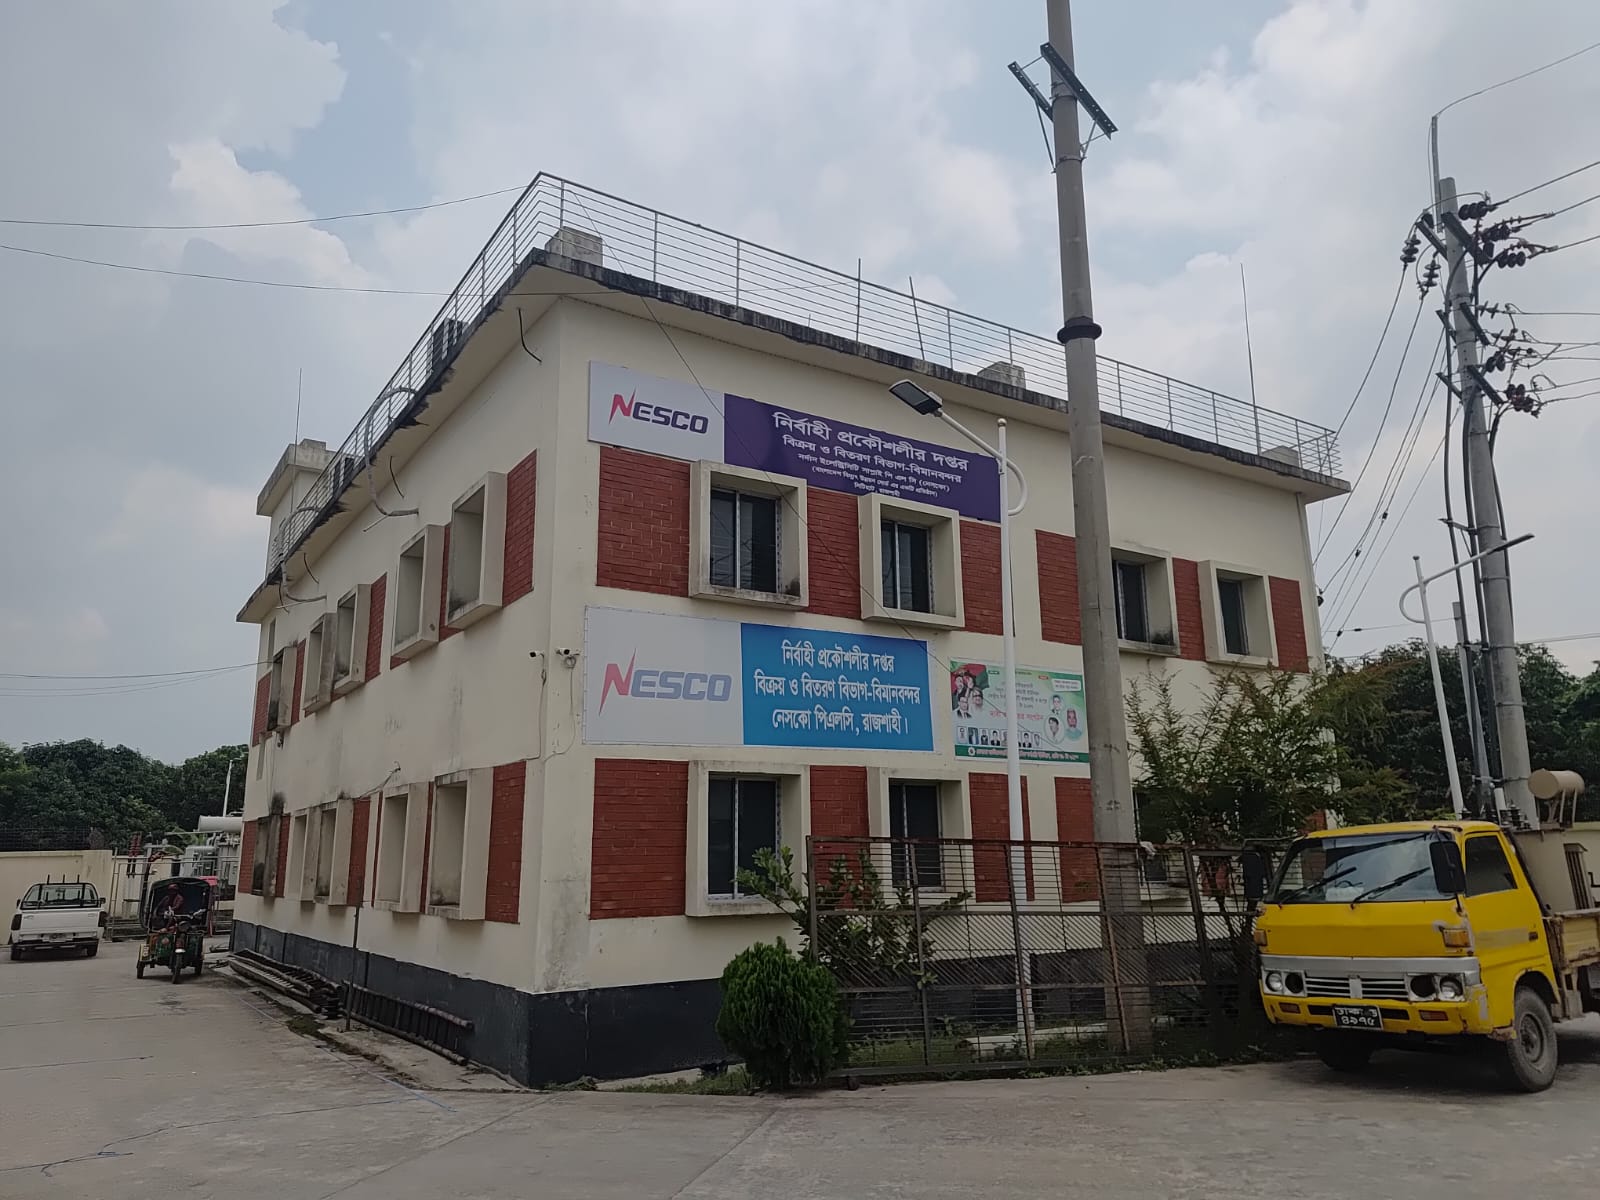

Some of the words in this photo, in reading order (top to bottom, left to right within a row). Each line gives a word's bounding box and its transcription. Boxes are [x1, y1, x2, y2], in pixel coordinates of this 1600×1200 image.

[608, 387, 709, 434] NESCO
[772, 411, 832, 441] নির্বাহী
[837, 432, 927, 463] প্রকৌশলীর
[930, 450, 969, 472] দপ্তর
[782, 434, 817, 452] বিক্রয়
[820, 444, 830, 454] ও
[833, 445, 870, 463] বিতরণ
[874, 453, 962, 484] বিভাগ-বিমানবন্দর
[781, 639, 815, 668] নির্বাহী
[817, 643, 869, 672] প্রকৌশলীর
[872, 652, 895, 673] দপ্তর
[598, 648, 732, 717] NESCO
[753, 668, 786, 696] বিক্রয়
[789, 679, 798, 696] ও
[801, 672, 835, 699] বিতরণ
[838, 674, 921, 704] বিভাগ-বিমানবন্দর
[772, 707, 811, 730] নেসকো
